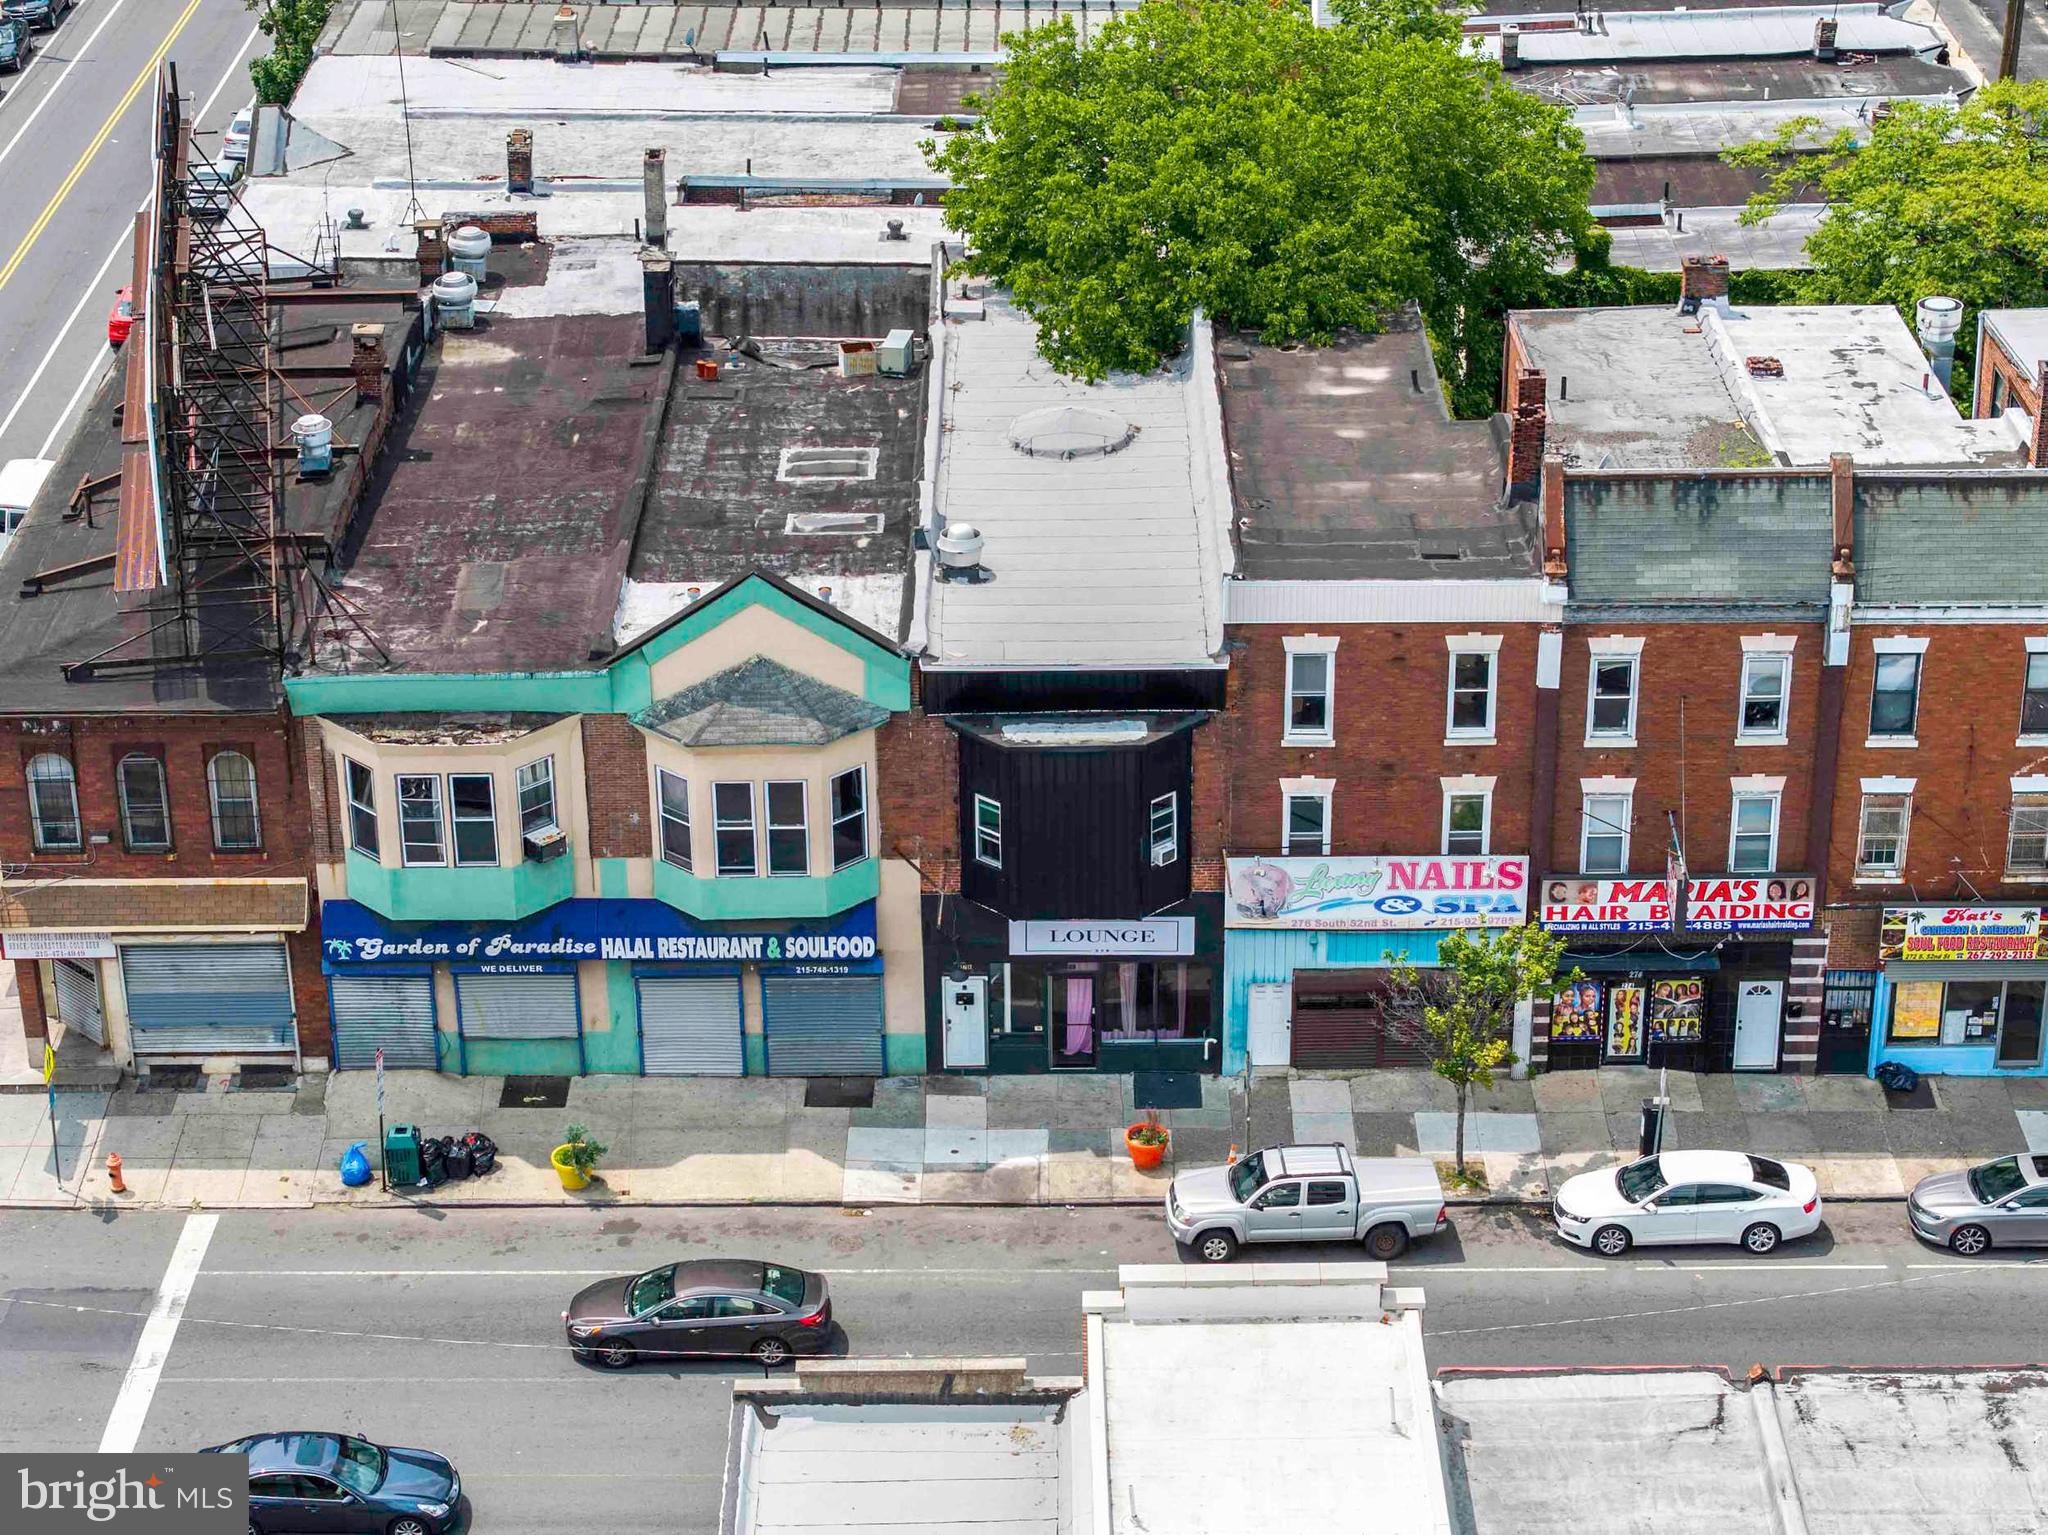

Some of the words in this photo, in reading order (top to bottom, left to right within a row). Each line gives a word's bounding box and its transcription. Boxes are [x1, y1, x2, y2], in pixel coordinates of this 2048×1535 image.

[1387, 862, 1524, 891] NAILS
[1433, 894, 1522, 914] SPA
[1546, 906, 1629, 921] HAIR
[1650, 904, 1810, 920] BAIDING
[1942, 908, 2003, 924] Kat's
[1315, 919, 1346, 928] South
[1581, 923, 1587, 931] IN
[1589, 923, 1599, 931] ALL
[1980, 925, 2026, 935] AMERICAN
[1050, 929, 1155, 943] LOUNGE
[1907, 936, 1935, 951] SOUL
[1937, 936, 1964, 951] FOOD
[1966, 936, 2037, 950] RESTAURANT
[356, 937, 450, 959] Garden
[456, 938, 480, 956] of
[485, 934, 596, 956] Paradise
[601, 937, 654, 959] HALAL
[657, 937, 763, 959] RESTAURANT
[767, 937, 781, 959] &
[785, 936, 875, 958] SOULFOOD
[1967, 951, 2033, 959] 267-292-2113
[481, 965, 497, 973] WE
[499, 965, 543, 973] DELIVER
